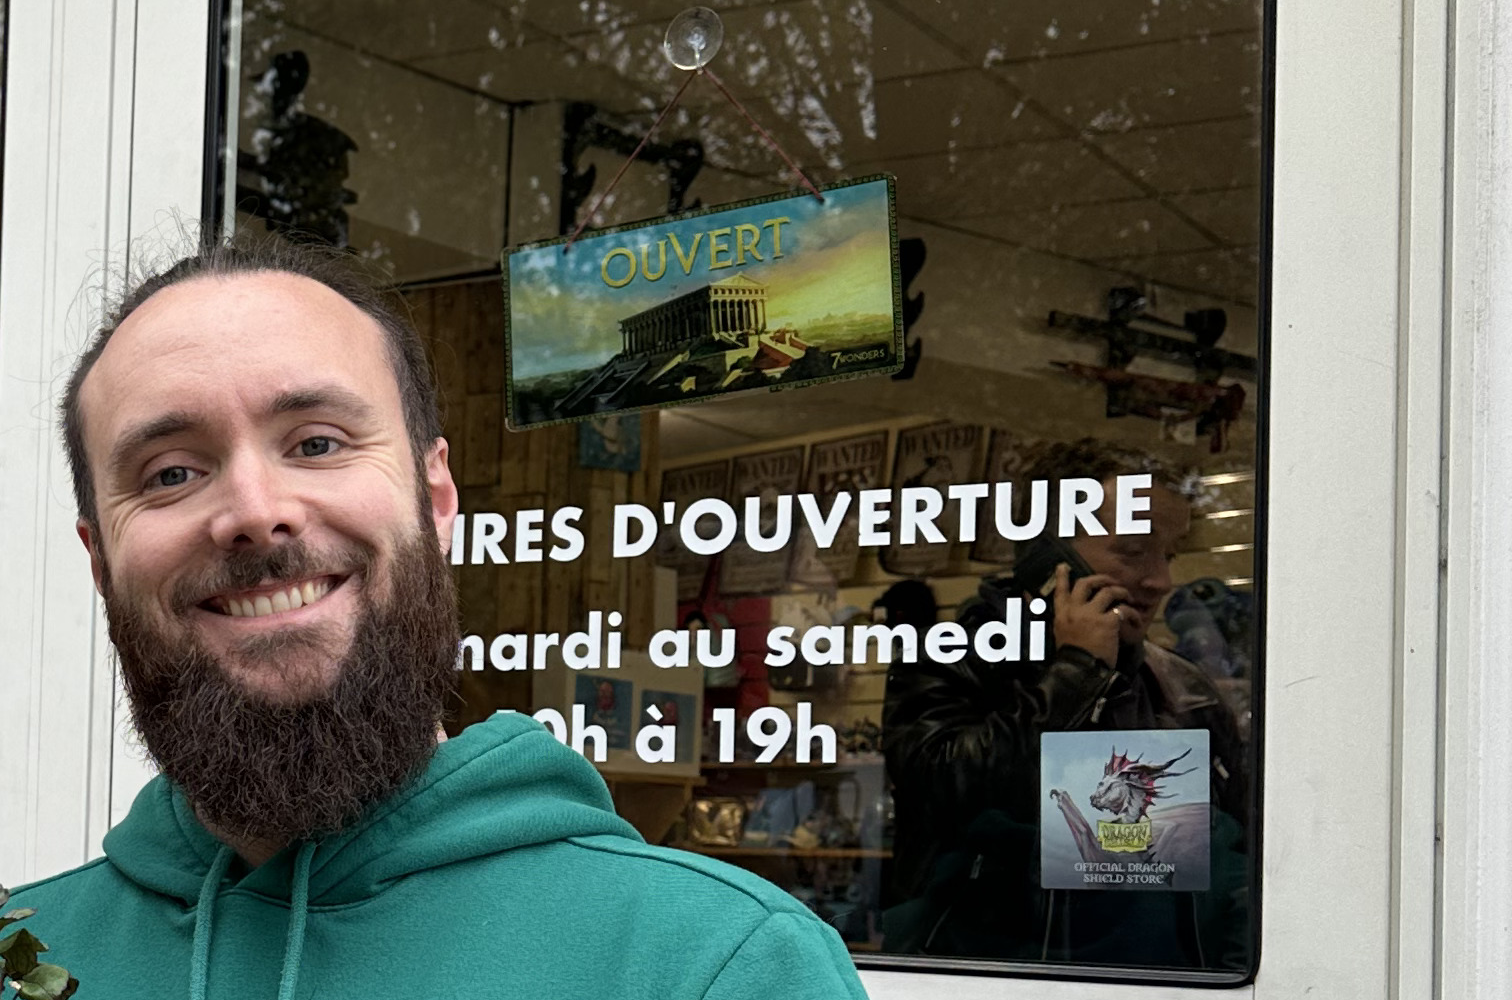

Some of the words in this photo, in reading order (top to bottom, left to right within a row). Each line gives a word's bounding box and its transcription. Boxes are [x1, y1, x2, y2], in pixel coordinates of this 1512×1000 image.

[601, 217, 790, 288] OUVERT
[839, 348, 886, 363] WONDERS
[451, 506, 585, 565] IRES
[613, 473, 1153, 558] D'OUVERTURE
[649, 628, 735, 668] au
[765, 597, 1046, 667] samedi
[635, 704, 676, 763] à
[712, 702, 837, 763] 19h
[1074, 862, 1125, 873] OFFICIAL
[1127, 862, 1175, 873] DRAGON
[1083, 873, 1124, 884] SHIELD
